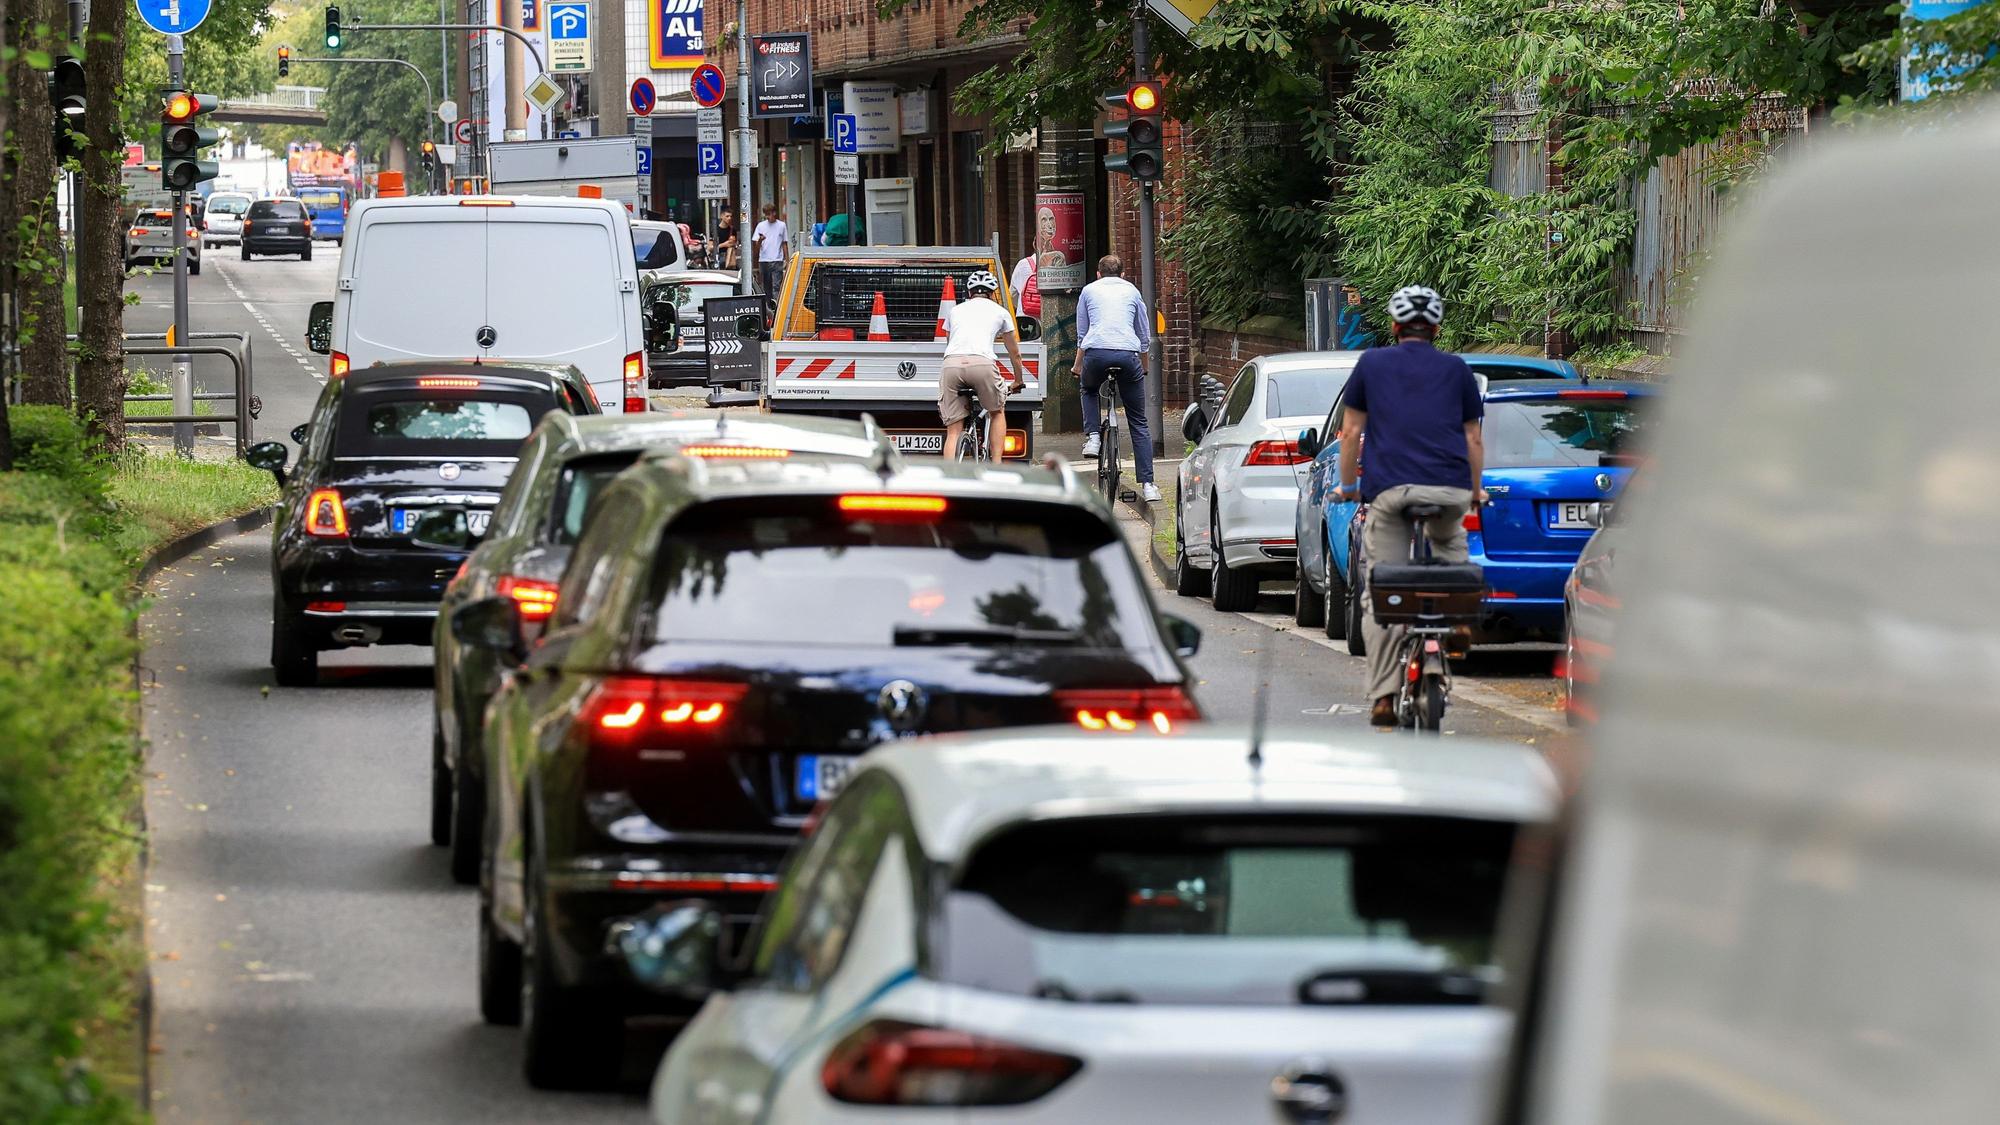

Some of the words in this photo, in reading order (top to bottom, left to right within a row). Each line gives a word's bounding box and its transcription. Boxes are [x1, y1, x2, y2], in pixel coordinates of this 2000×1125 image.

[562, 16, 577, 37] P
[666, 17, 703, 37] AL
[686, 37, 703, 50] SÜ
[769, 46, 800, 54] FITNESS
[836, 119, 850, 148] P
[702, 147, 716, 171] P
[735, 306, 760, 314] LAGER
[898, 436, 912, 448] LW
[914, 436, 941, 449] 1268
